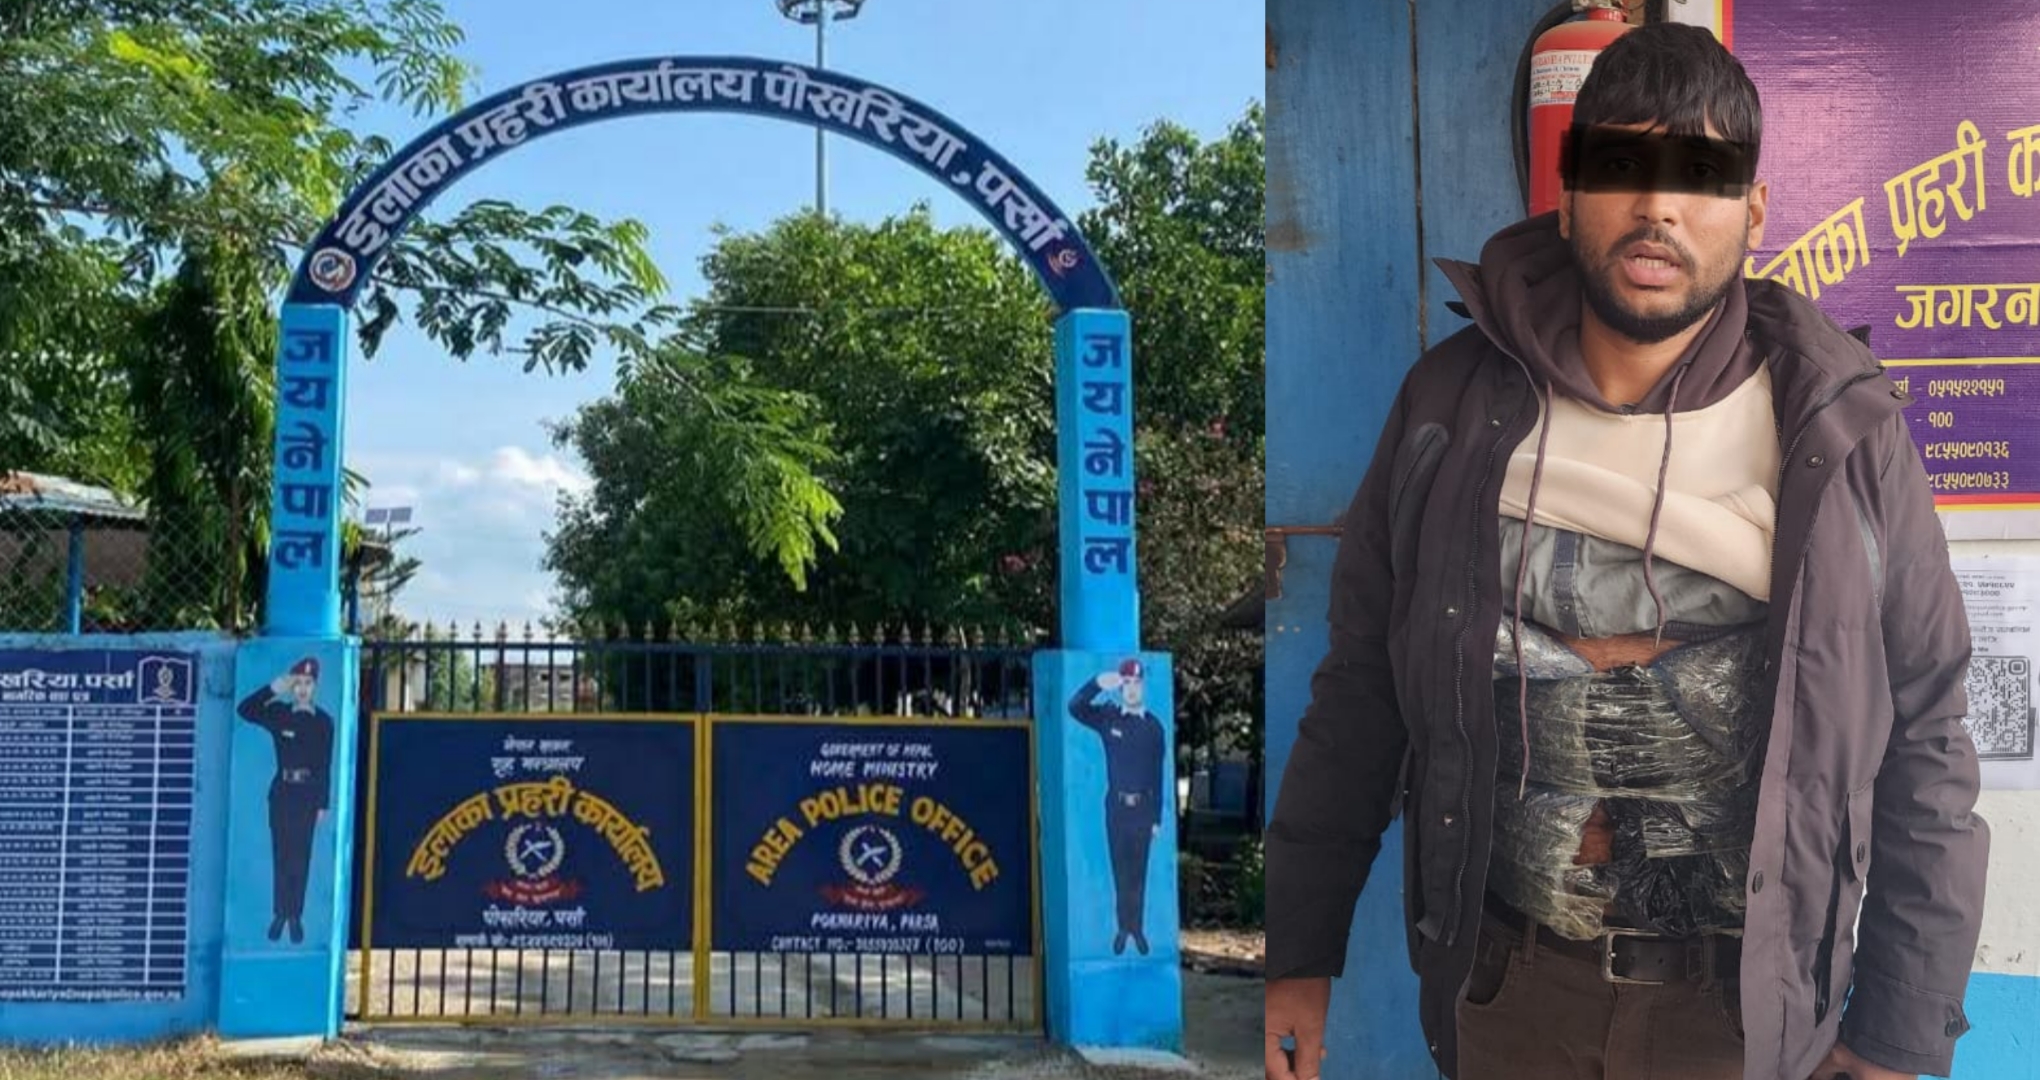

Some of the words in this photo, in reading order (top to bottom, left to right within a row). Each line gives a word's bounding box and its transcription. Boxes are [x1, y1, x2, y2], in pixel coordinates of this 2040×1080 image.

[334, 134, 464, 257] इलाका
[456, 82, 566, 160] प्रहरी
[567, 60, 756, 113] कार्यालय
[975, 160, 1069, 252] पर्सा
[1744, 196, 1870, 300] लाका
[1884, 119, 1987, 258] प्रहरी
[1927, 411, 1953, 428] १००
[1928, 378, 2005, 398] ०५१५२२१५१
[810, 761, 856, 777] HOME
[863, 761, 940, 780] MINISTRY
[408, 793, 492, 879] इलाका
[497, 777, 575, 818] प्रहरी
[576, 792, 664, 891] कार्यालय
[747, 818, 803, 885] AREA
[801, 784, 904, 826] POLICE
[912, 798, 998, 890] OFFICE
